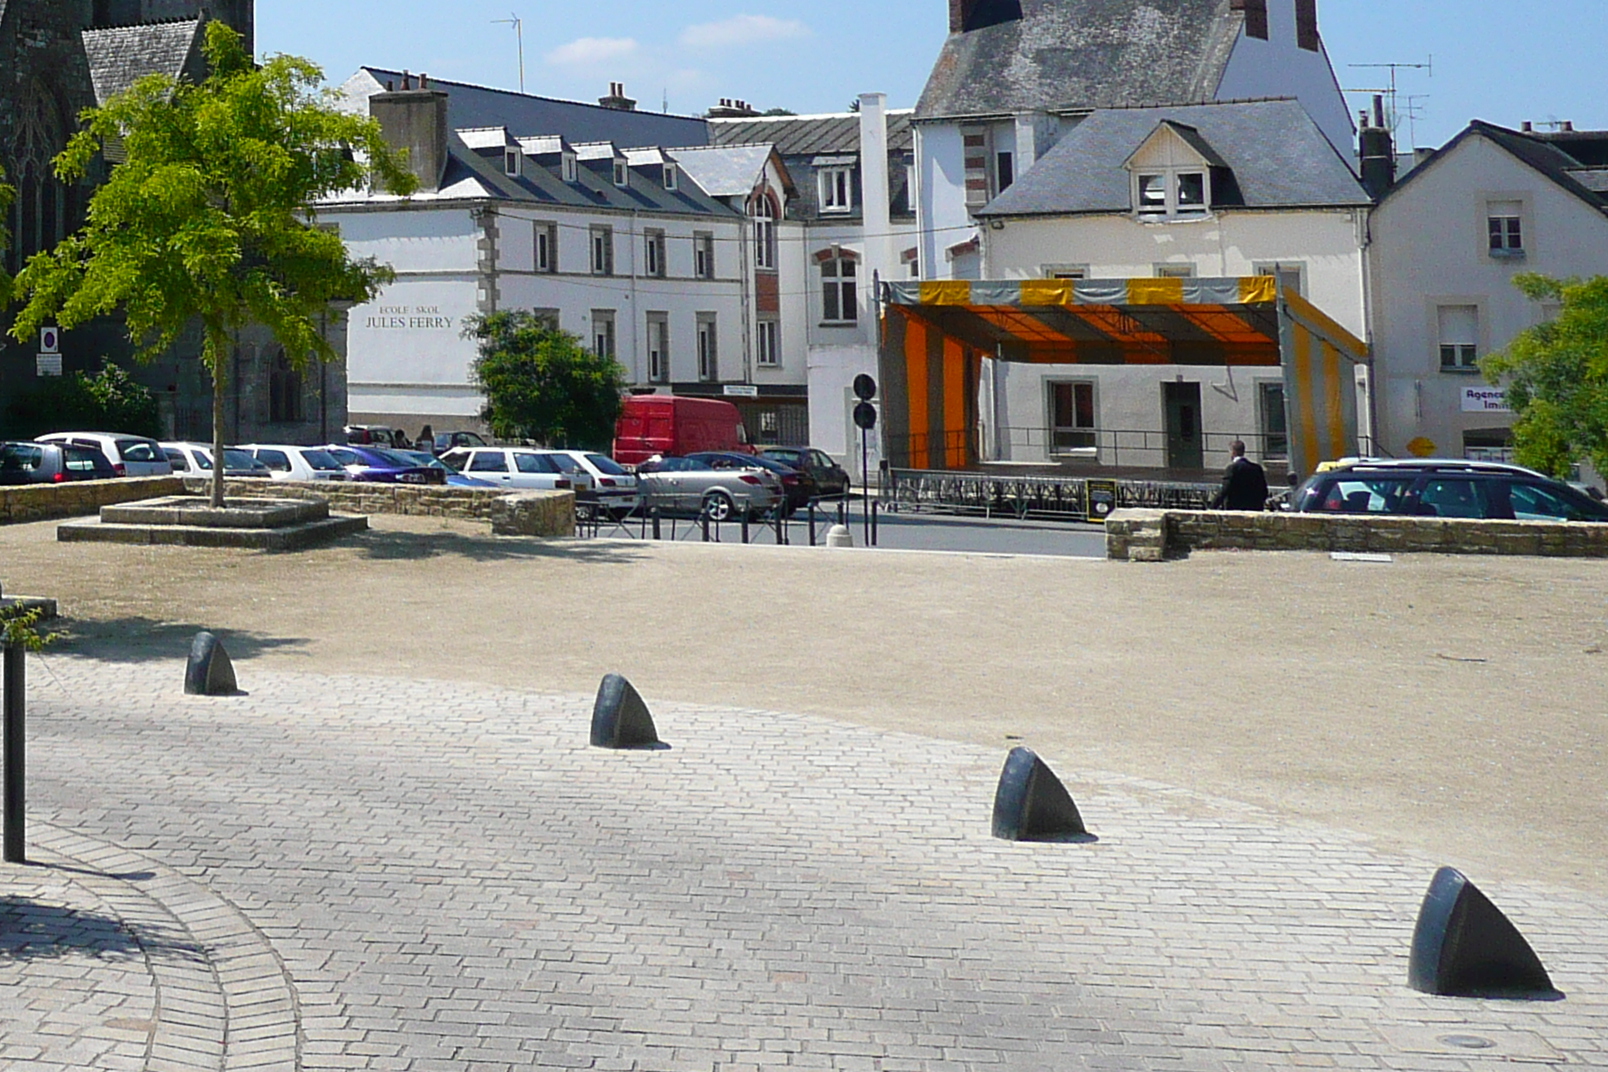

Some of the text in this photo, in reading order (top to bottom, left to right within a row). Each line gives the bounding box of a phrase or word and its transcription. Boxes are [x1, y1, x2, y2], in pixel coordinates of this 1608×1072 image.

[416, 306, 440, 314] SKOL
[366, 316, 453, 328] JULES FERRY
